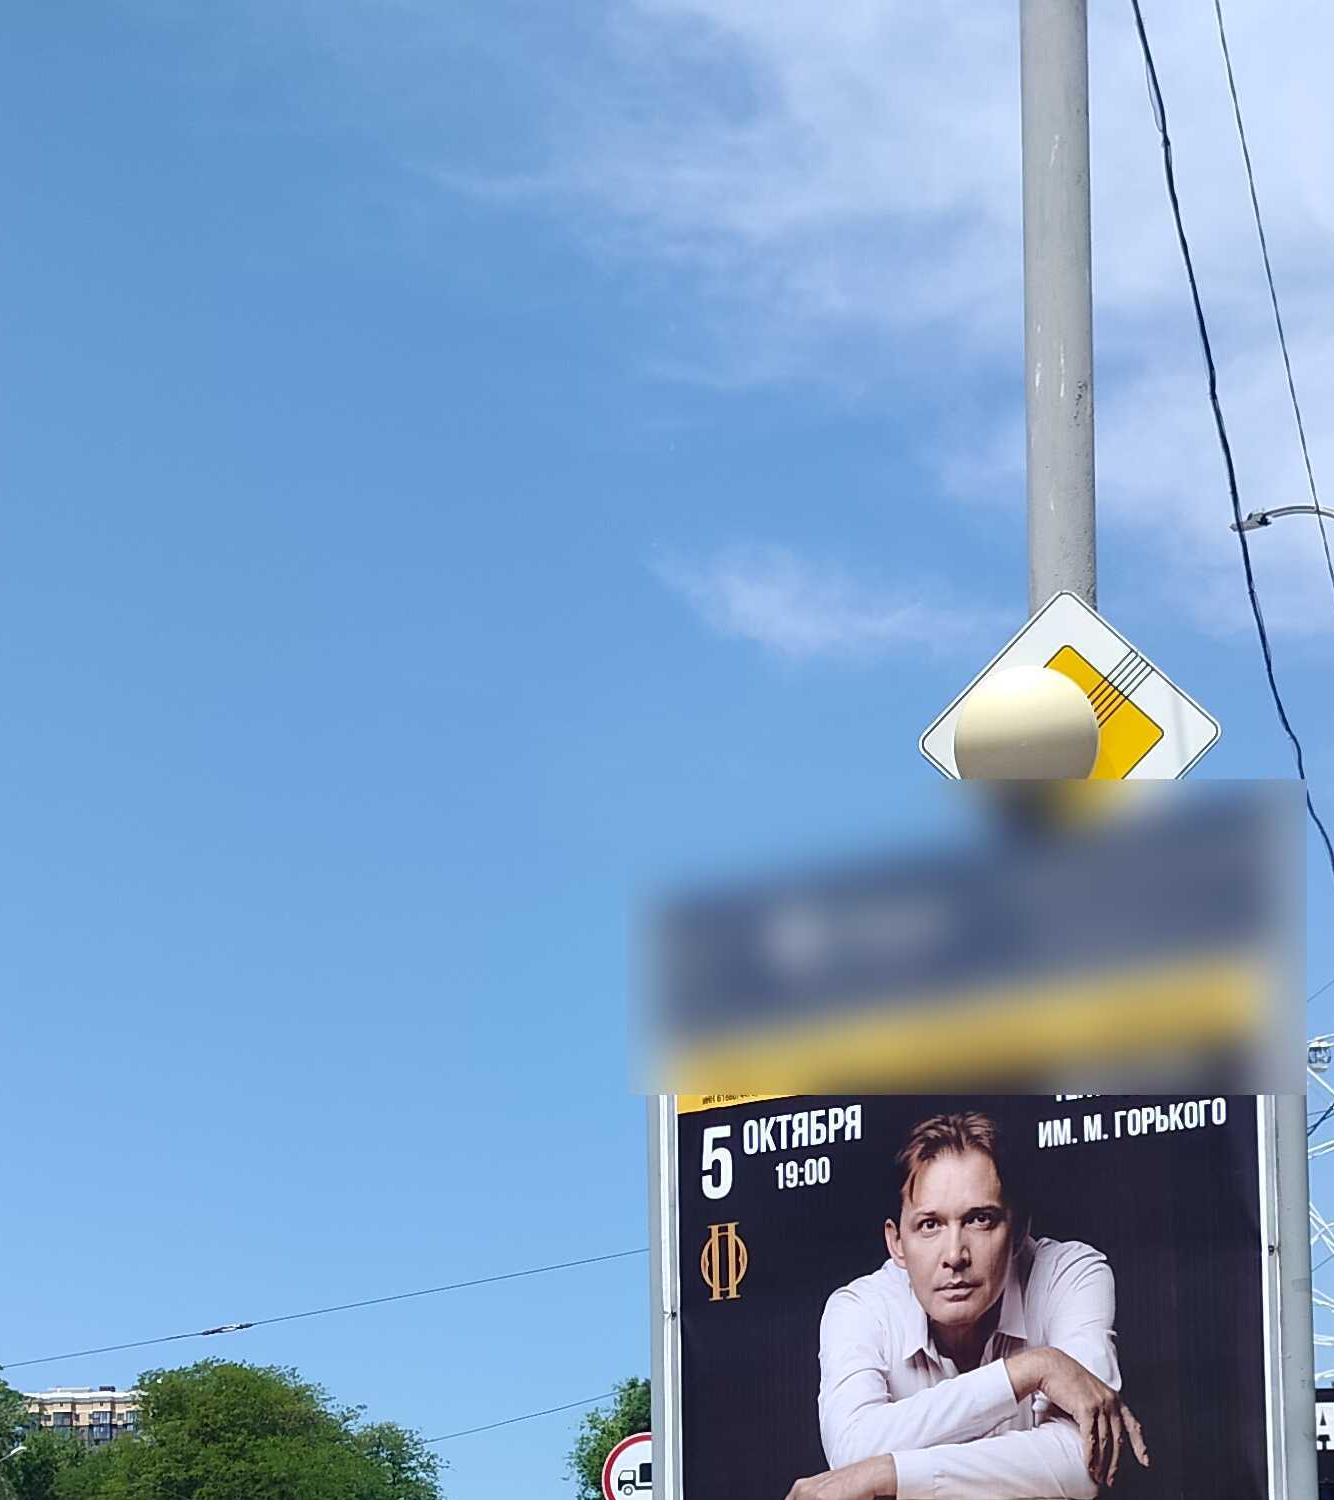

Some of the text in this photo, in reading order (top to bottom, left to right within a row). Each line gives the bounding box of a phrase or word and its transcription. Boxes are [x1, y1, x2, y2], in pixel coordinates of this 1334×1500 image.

[1038, 1097, 1227, 1148] ИМ. М. ГОРЬКОГО
[701, 1104, 862, 1200] 5 ОКТЯБРЯ
[775, 1156, 831, 1190] 19:00
